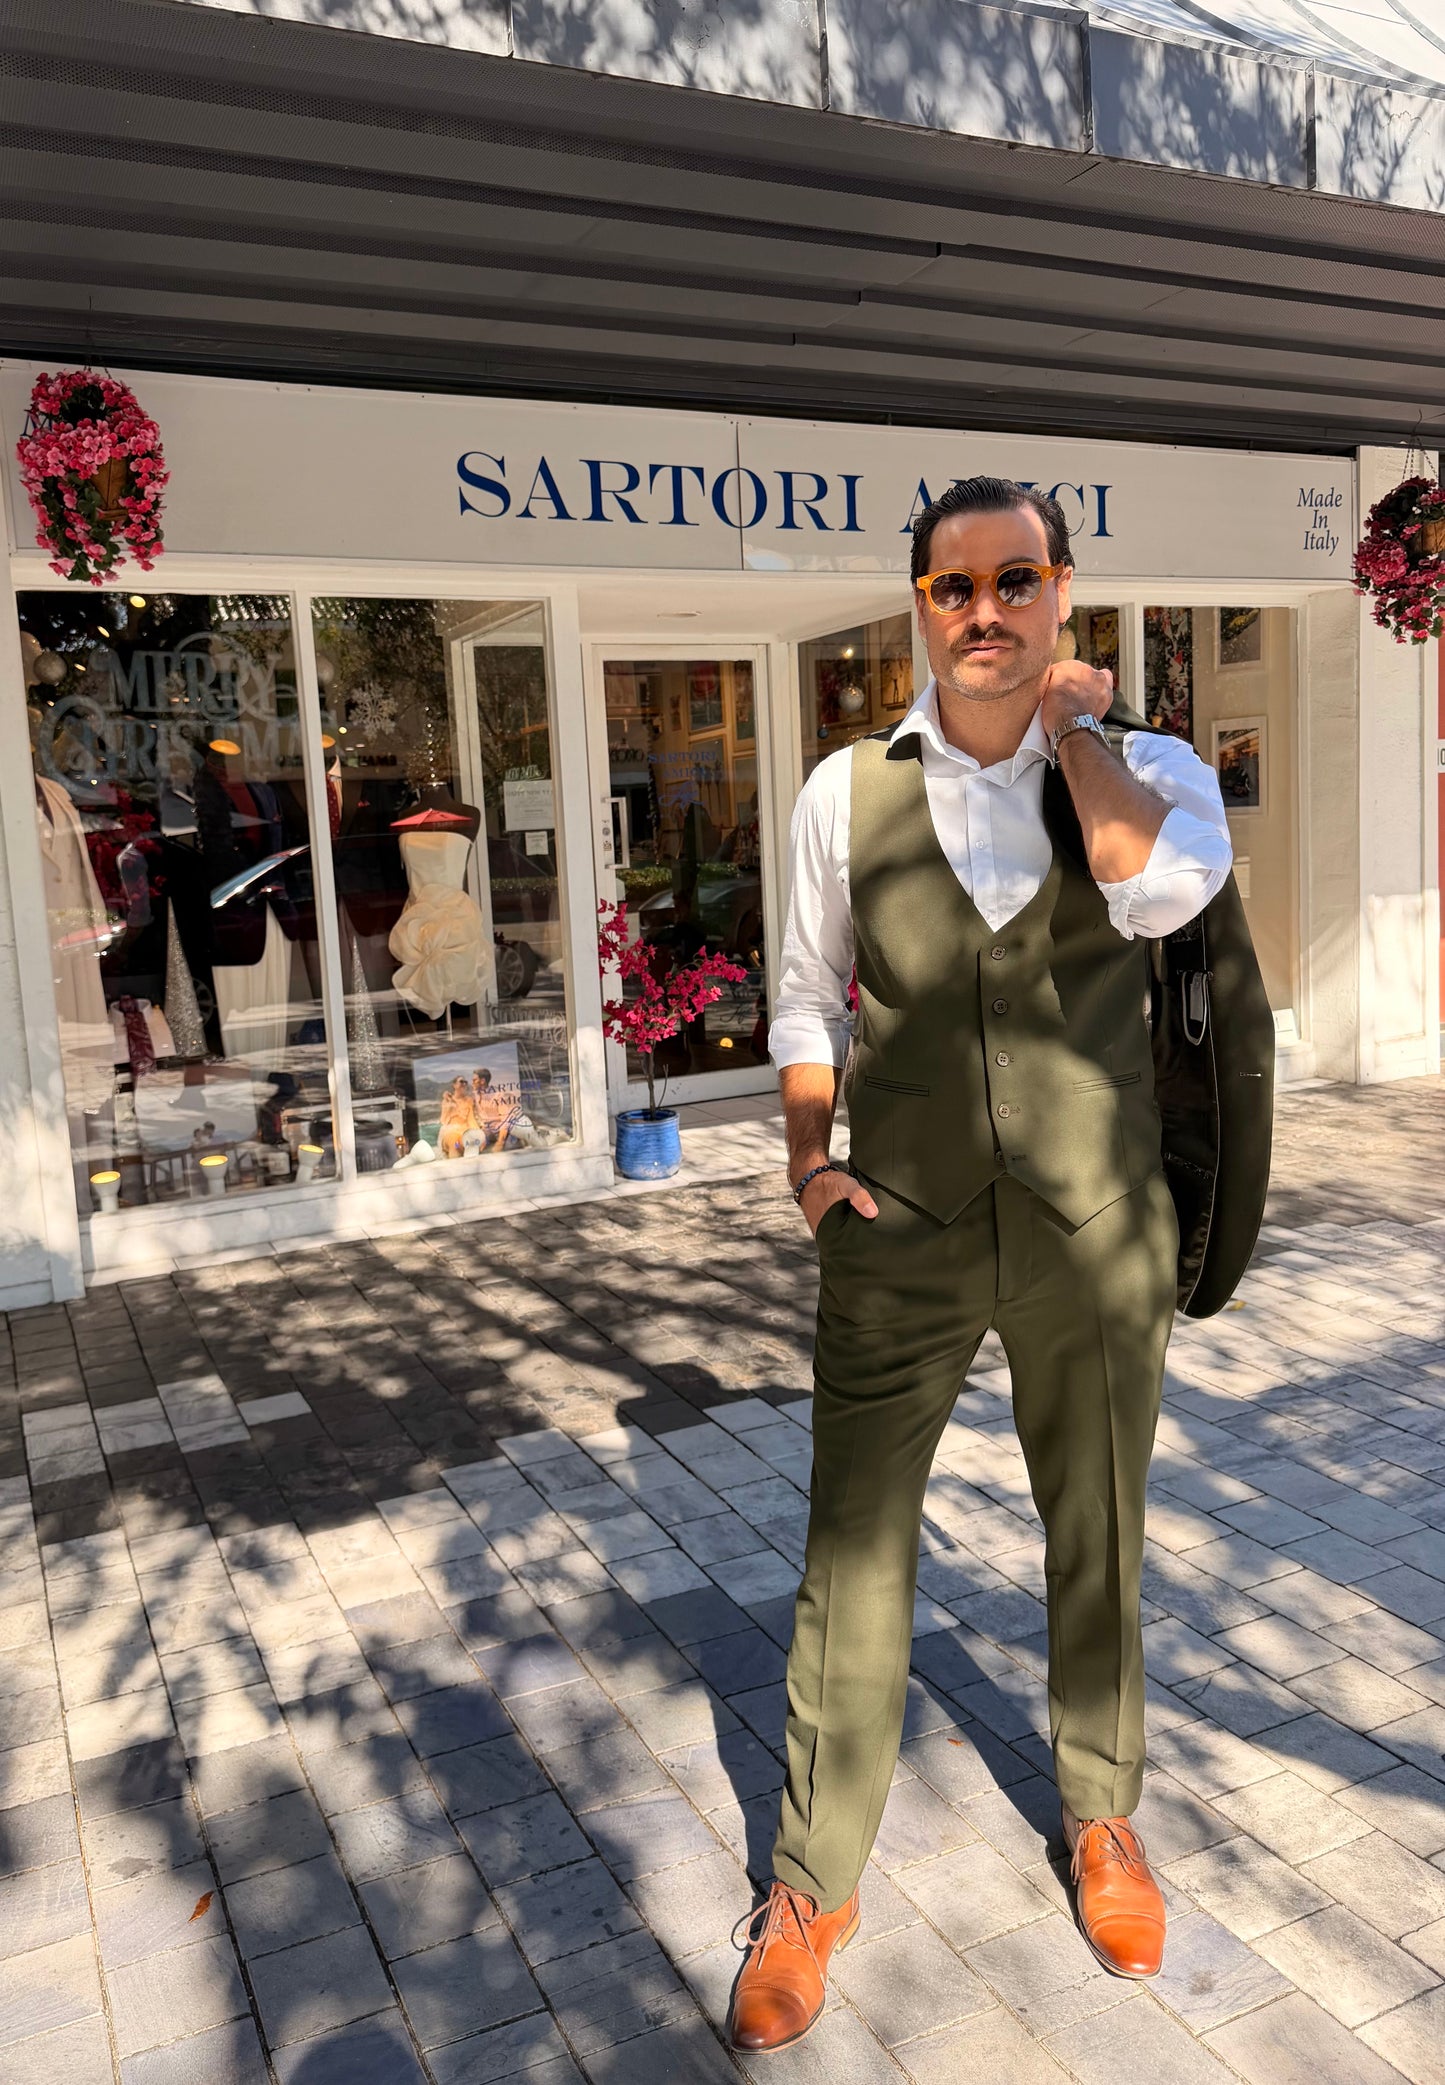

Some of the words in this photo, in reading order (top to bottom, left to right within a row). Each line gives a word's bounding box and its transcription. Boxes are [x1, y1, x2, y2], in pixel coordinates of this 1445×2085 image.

[457, 451, 866, 532] SARTORI
[900, 477, 1113, 537] ACI
[1297, 487, 1343, 507] Made
[1312, 510, 1328, 528] In
[1304, 530, 1339, 557] Italy
